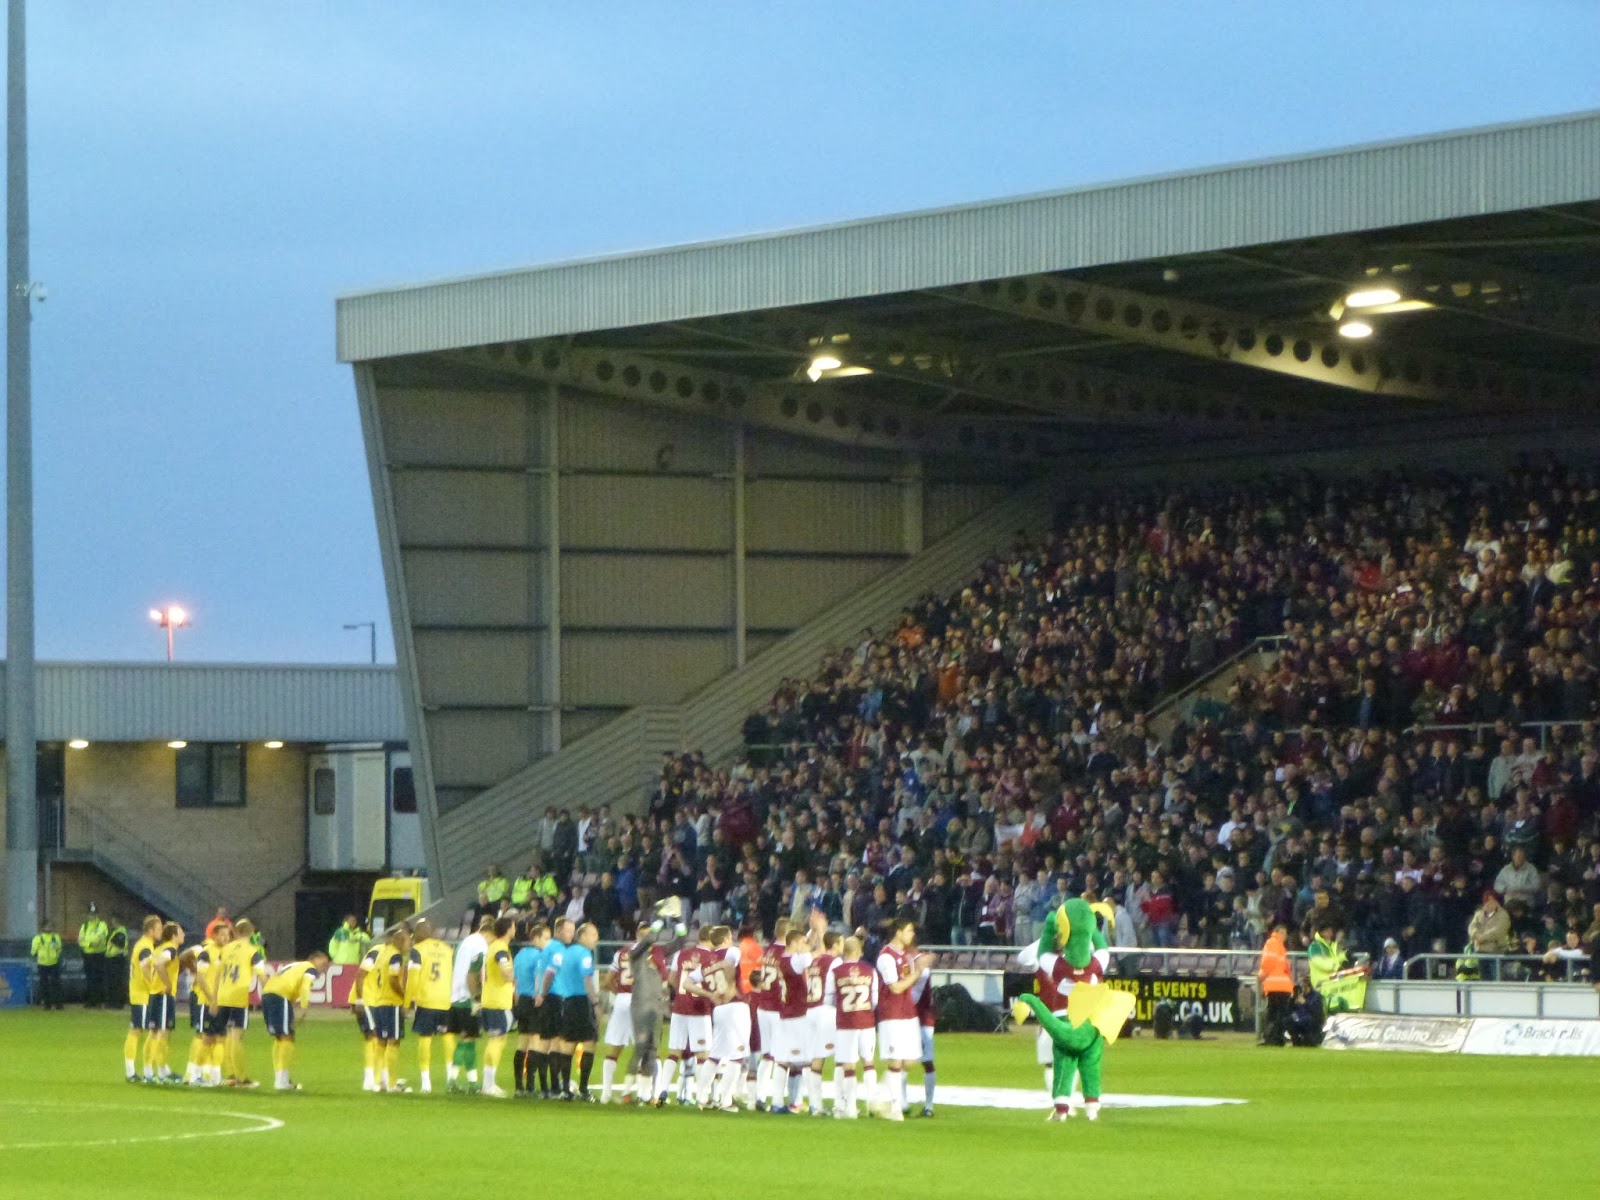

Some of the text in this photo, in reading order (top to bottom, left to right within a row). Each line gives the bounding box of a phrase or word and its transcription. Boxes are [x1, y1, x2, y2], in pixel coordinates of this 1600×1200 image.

[428, 963, 441, 982] 5
[840, 985, 871, 1012] 22
[1104, 980, 1139, 996] ORTS
[1153, 981, 1207, 999] EVENTS
[1383, 1025, 1430, 1043] Casino
